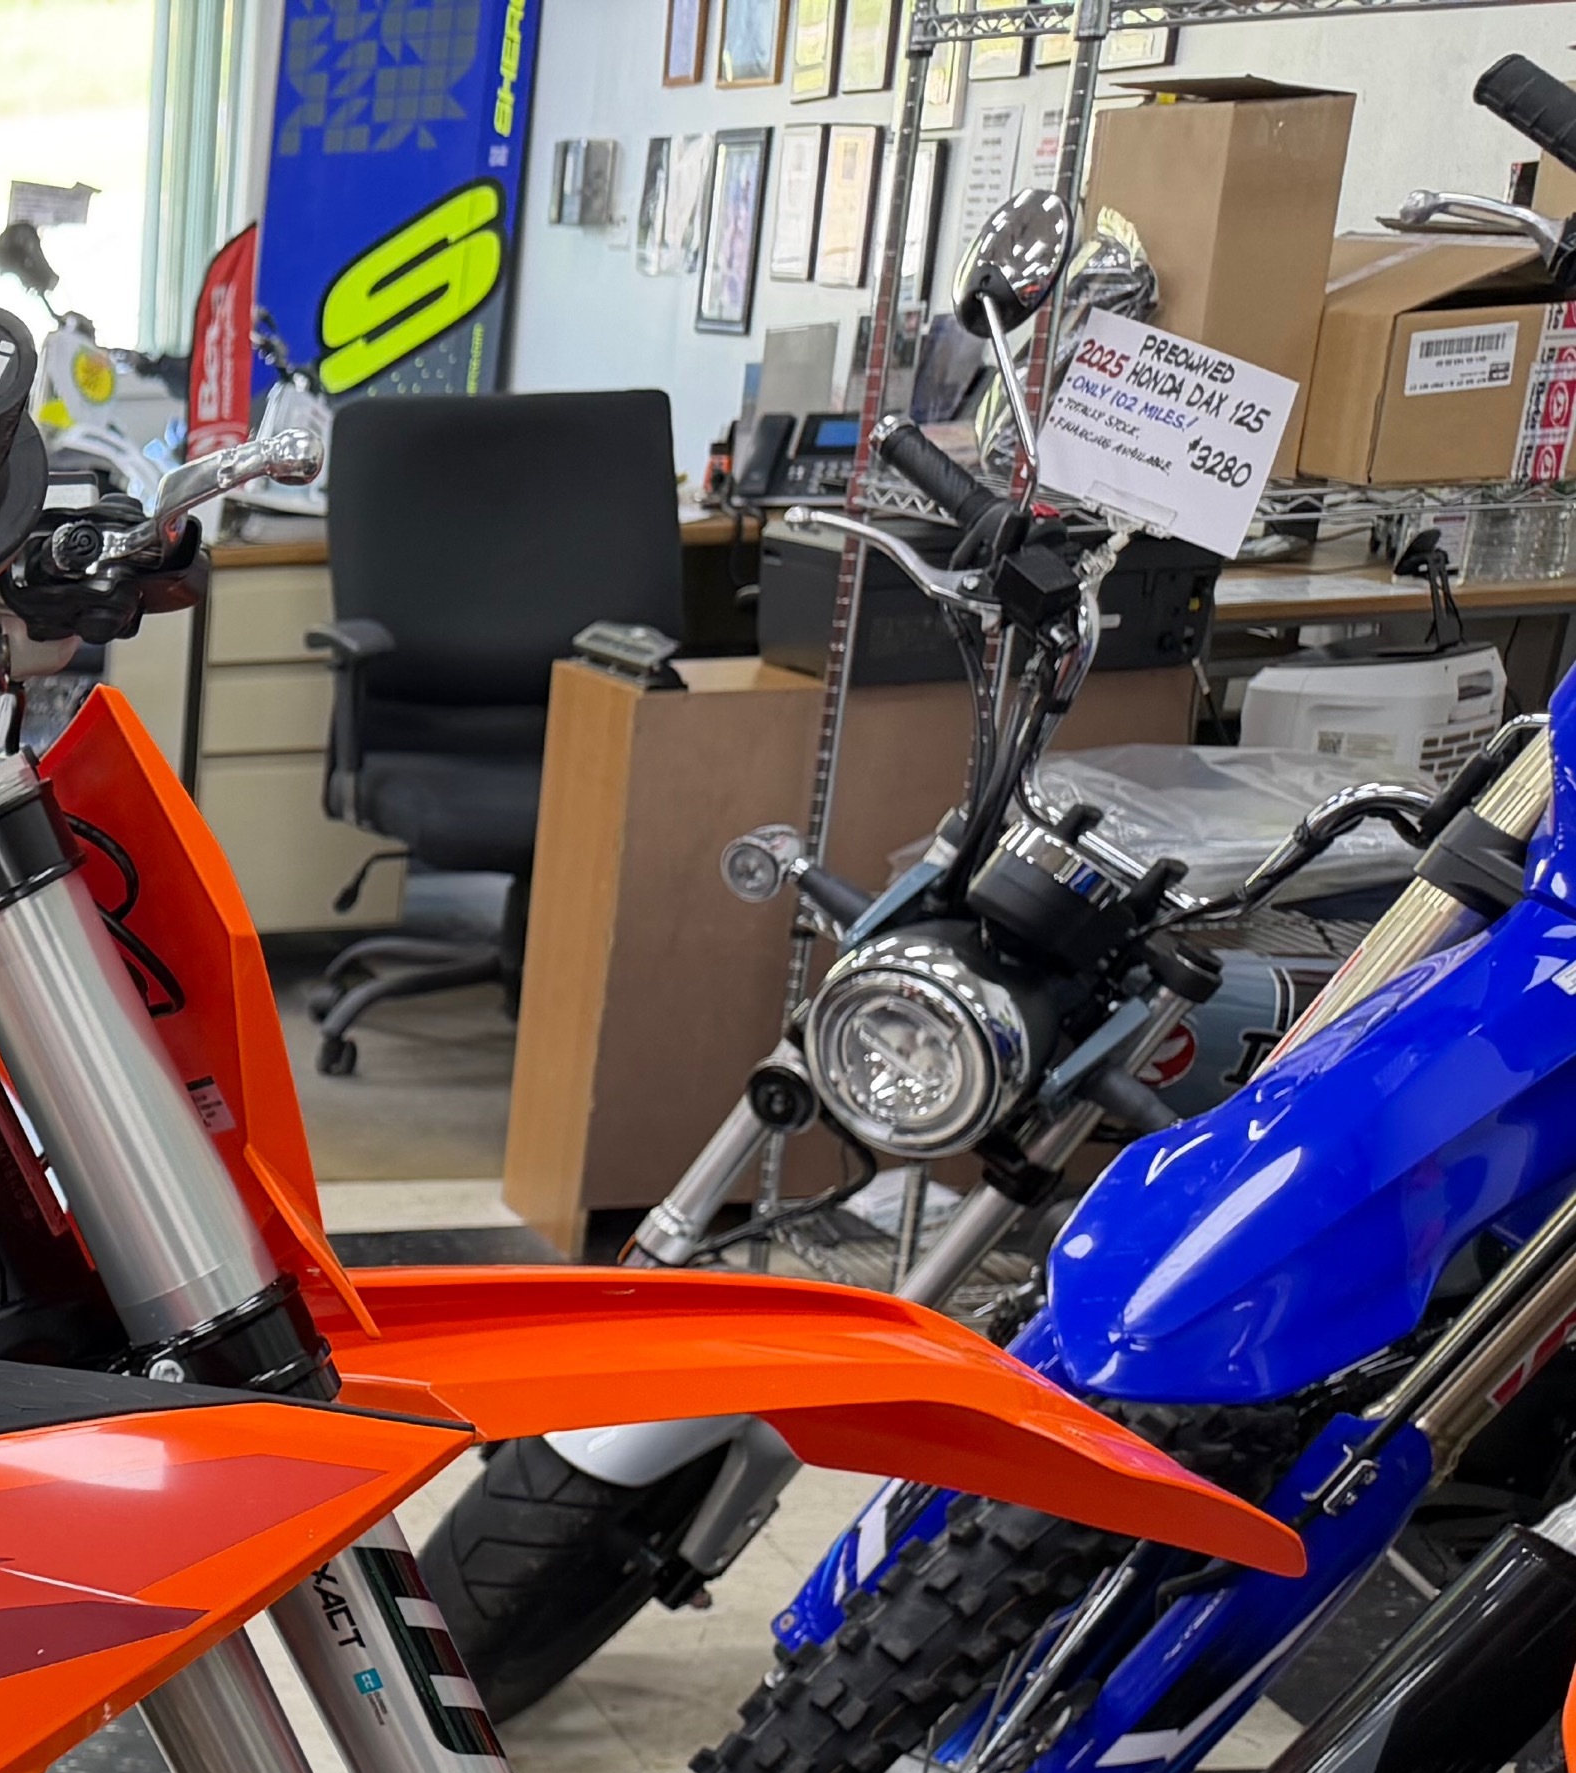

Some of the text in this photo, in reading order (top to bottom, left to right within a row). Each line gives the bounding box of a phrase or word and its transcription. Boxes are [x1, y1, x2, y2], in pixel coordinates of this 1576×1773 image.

[494, 0, 525, 137] SHER
[1071, 374, 1113, 400] ONLY
[1109, 386, 1136, 412] 102
[1075, 338, 1272, 433] 2025 HONDA DAX 125
[1139, 334, 1236, 385] PREOWNED
[1186, 435, 1253, 488] $3280
[310, 1561, 367, 1650] XACT
